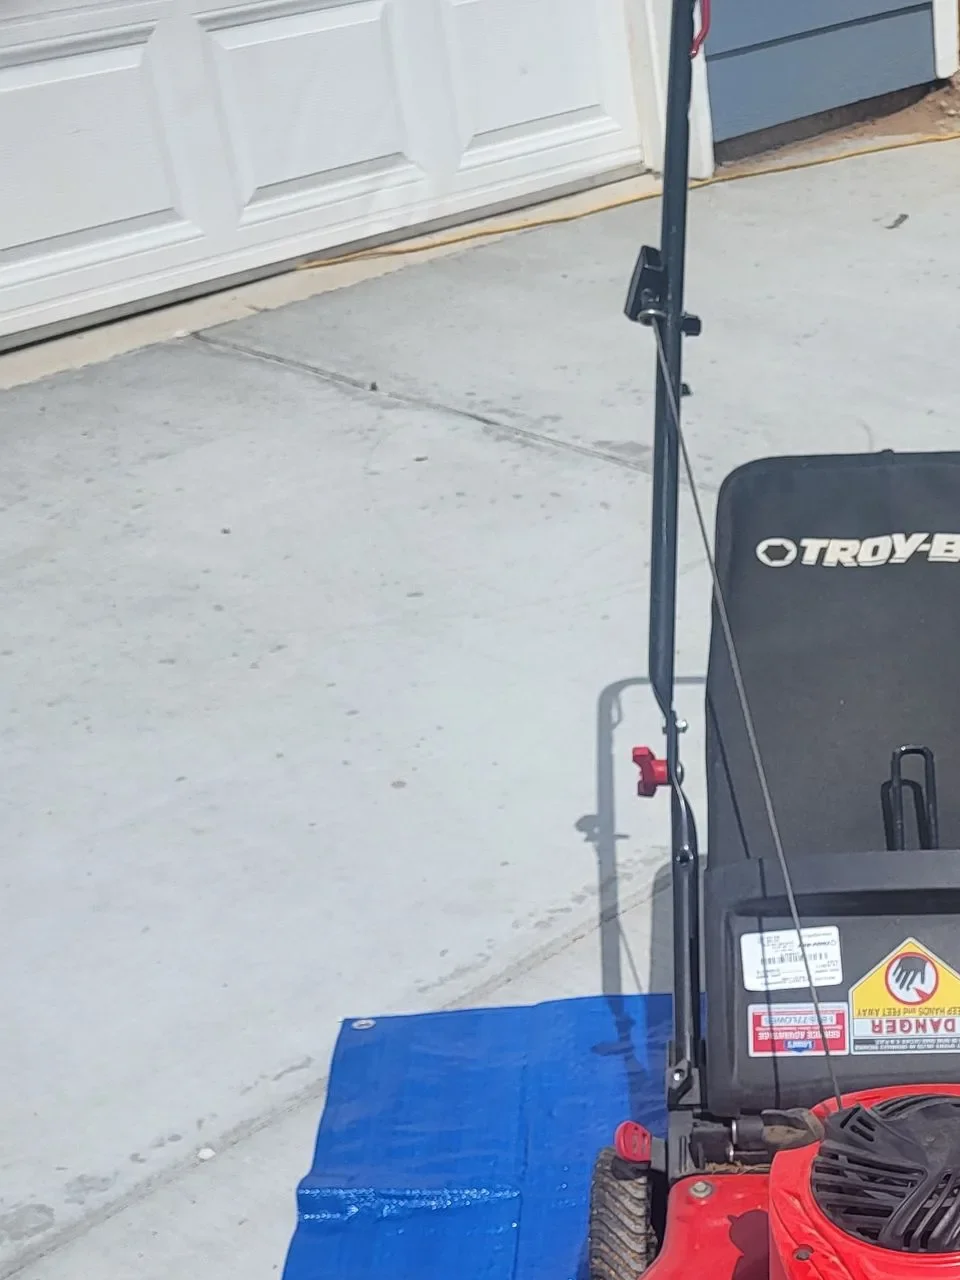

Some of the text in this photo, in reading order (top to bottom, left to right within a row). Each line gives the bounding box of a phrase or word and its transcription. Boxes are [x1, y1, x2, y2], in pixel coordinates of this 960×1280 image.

[856, 1008, 880, 1016] AWAY
[881, 1007, 901, 1016] FEET
[870, 1018, 956, 1034] DANGER
